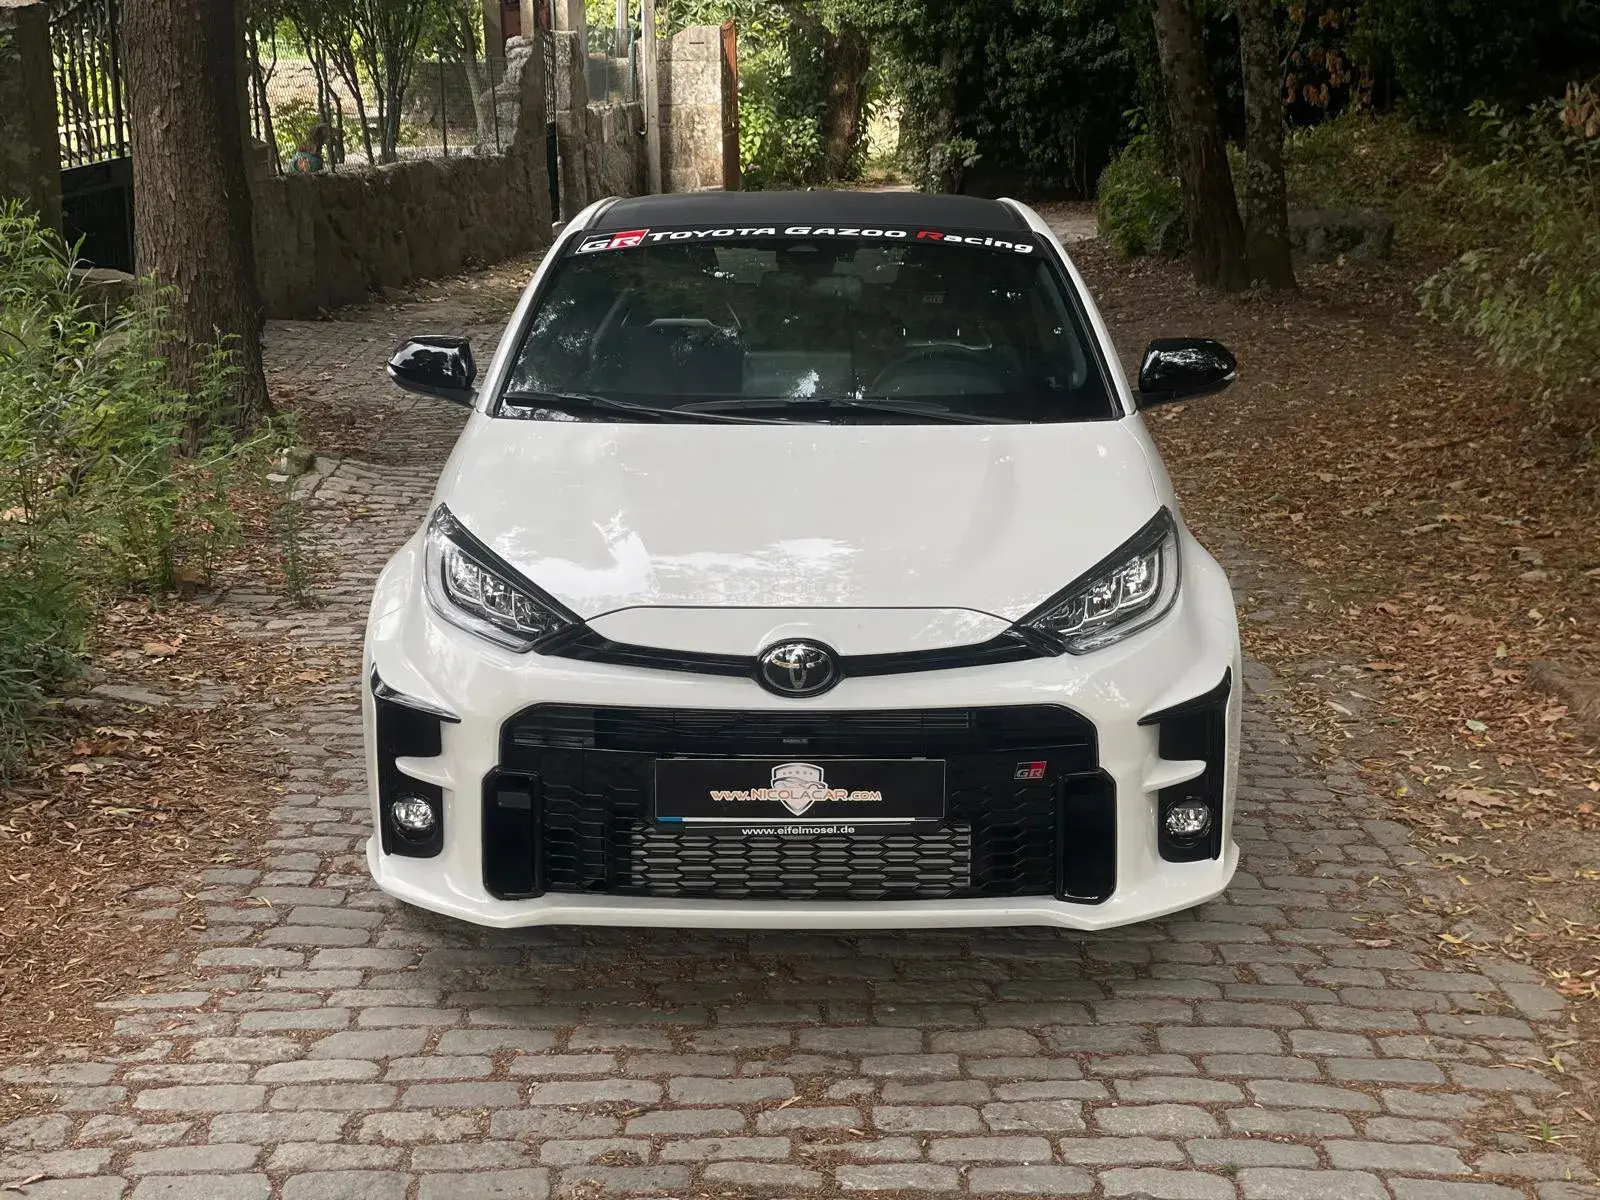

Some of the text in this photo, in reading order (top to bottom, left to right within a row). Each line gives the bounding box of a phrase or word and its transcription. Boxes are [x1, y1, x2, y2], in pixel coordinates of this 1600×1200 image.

[580, 226, 1033, 254] GR TOYOTA GAZOO Racing
[742, 825, 855, 836] www.eifelmosel.de
